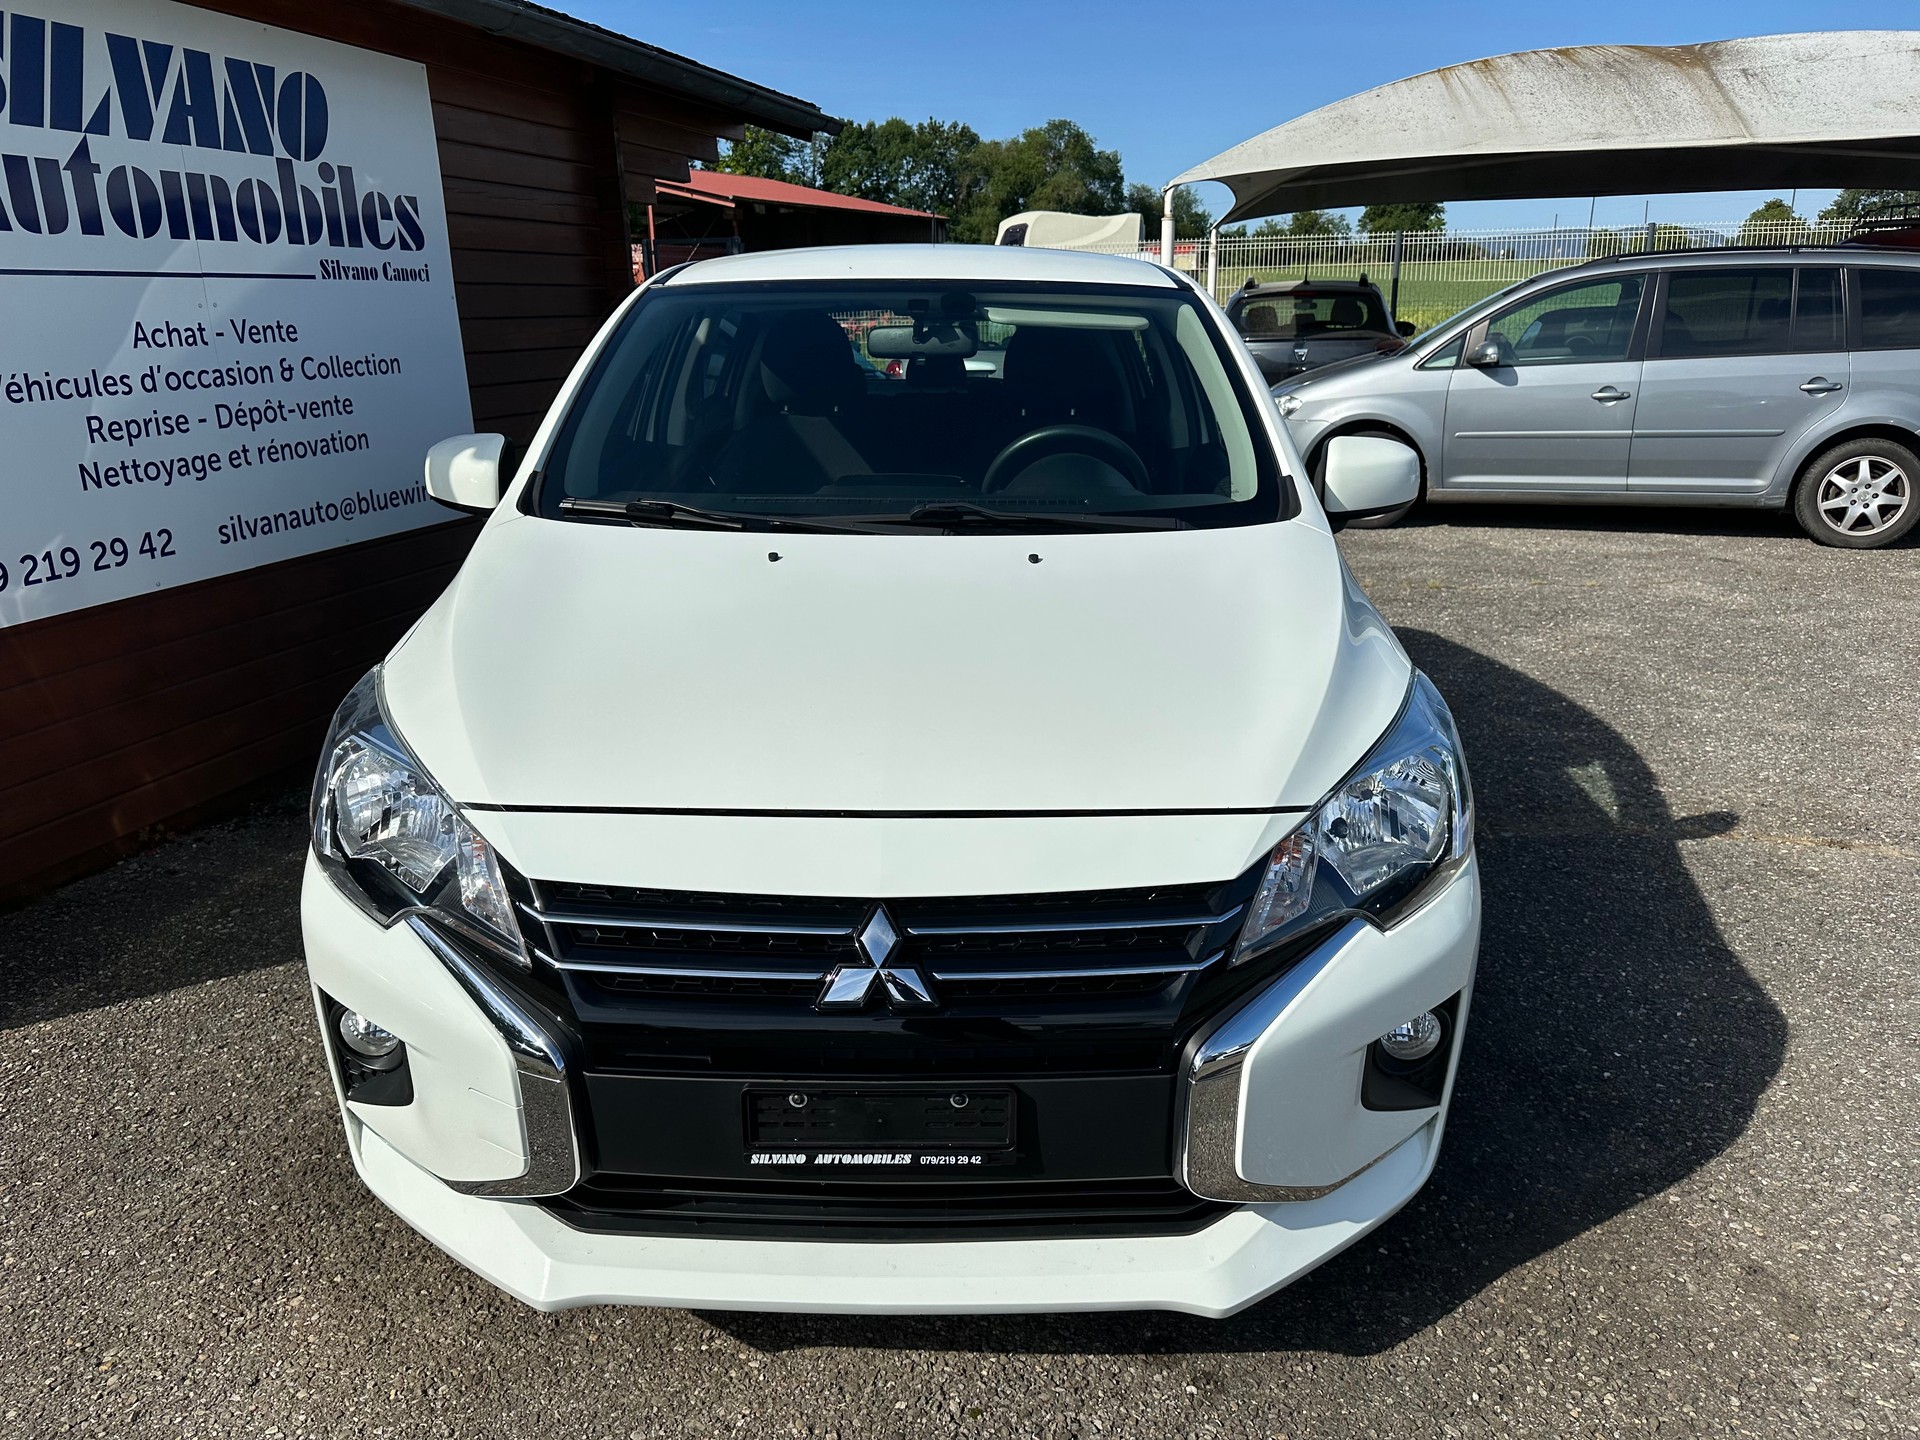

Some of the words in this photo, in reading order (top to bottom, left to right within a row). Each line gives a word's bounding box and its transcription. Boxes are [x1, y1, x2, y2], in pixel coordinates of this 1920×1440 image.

[0, 10, 329, 162] ILVANO
[0, 133, 426, 252] utomobiles
[319, 258, 379, 281] Silvano
[381, 261, 431, 283] Canoci
[133, 321, 209, 349] Achat
[229, 318, 299, 345] Vente
[0, 368, 133, 404] éhicules
[280, 357, 295, 383] &
[300, 353, 402, 381] Collection
[85, 410, 191, 447] Reprise
[214, 394, 354, 435] Dépôt-vente
[78, 453, 223, 492] Nettoyage
[228, 443, 253, 469] et
[257, 429, 370, 465] rénovation
[19, 547, 81, 587] 219
[89, 538, 129, 572] 29
[138, 528, 177, 560] 42
[750, 1153, 807, 1165] SILVANO
[814, 1153, 912, 1165] AUTOMOBILES
[920, 1155, 956, 1166] 079/219
[957, 1155, 969, 1165] 29
[970, 1155, 982, 1165] 42
